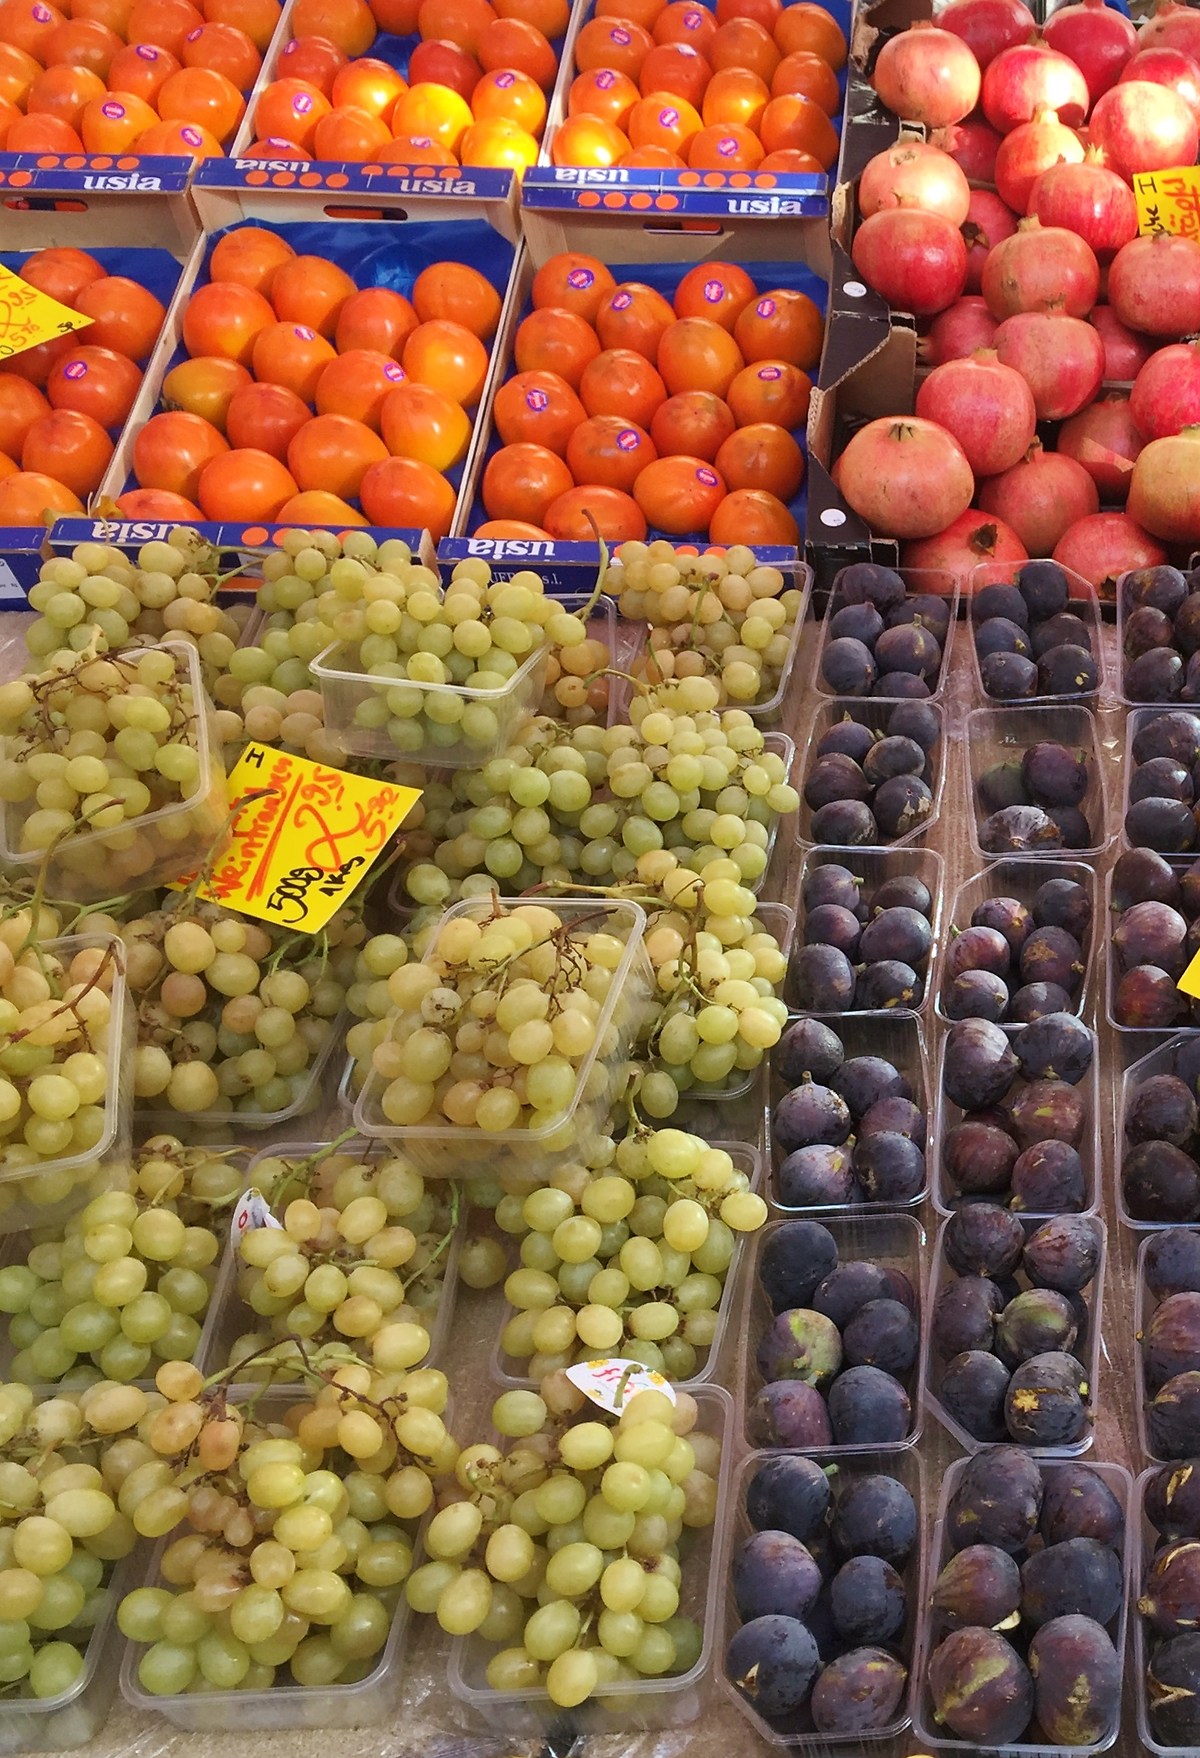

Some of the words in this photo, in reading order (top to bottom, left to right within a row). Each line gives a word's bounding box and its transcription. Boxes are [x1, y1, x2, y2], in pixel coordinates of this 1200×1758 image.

[83, 173, 161, 191] usia
[554, 167, 630, 185] usia
[400, 177, 476, 195] usia
[727, 196, 802, 215] usia
[467, 538, 555, 560] usia
[266, 867, 324, 923] 500g
